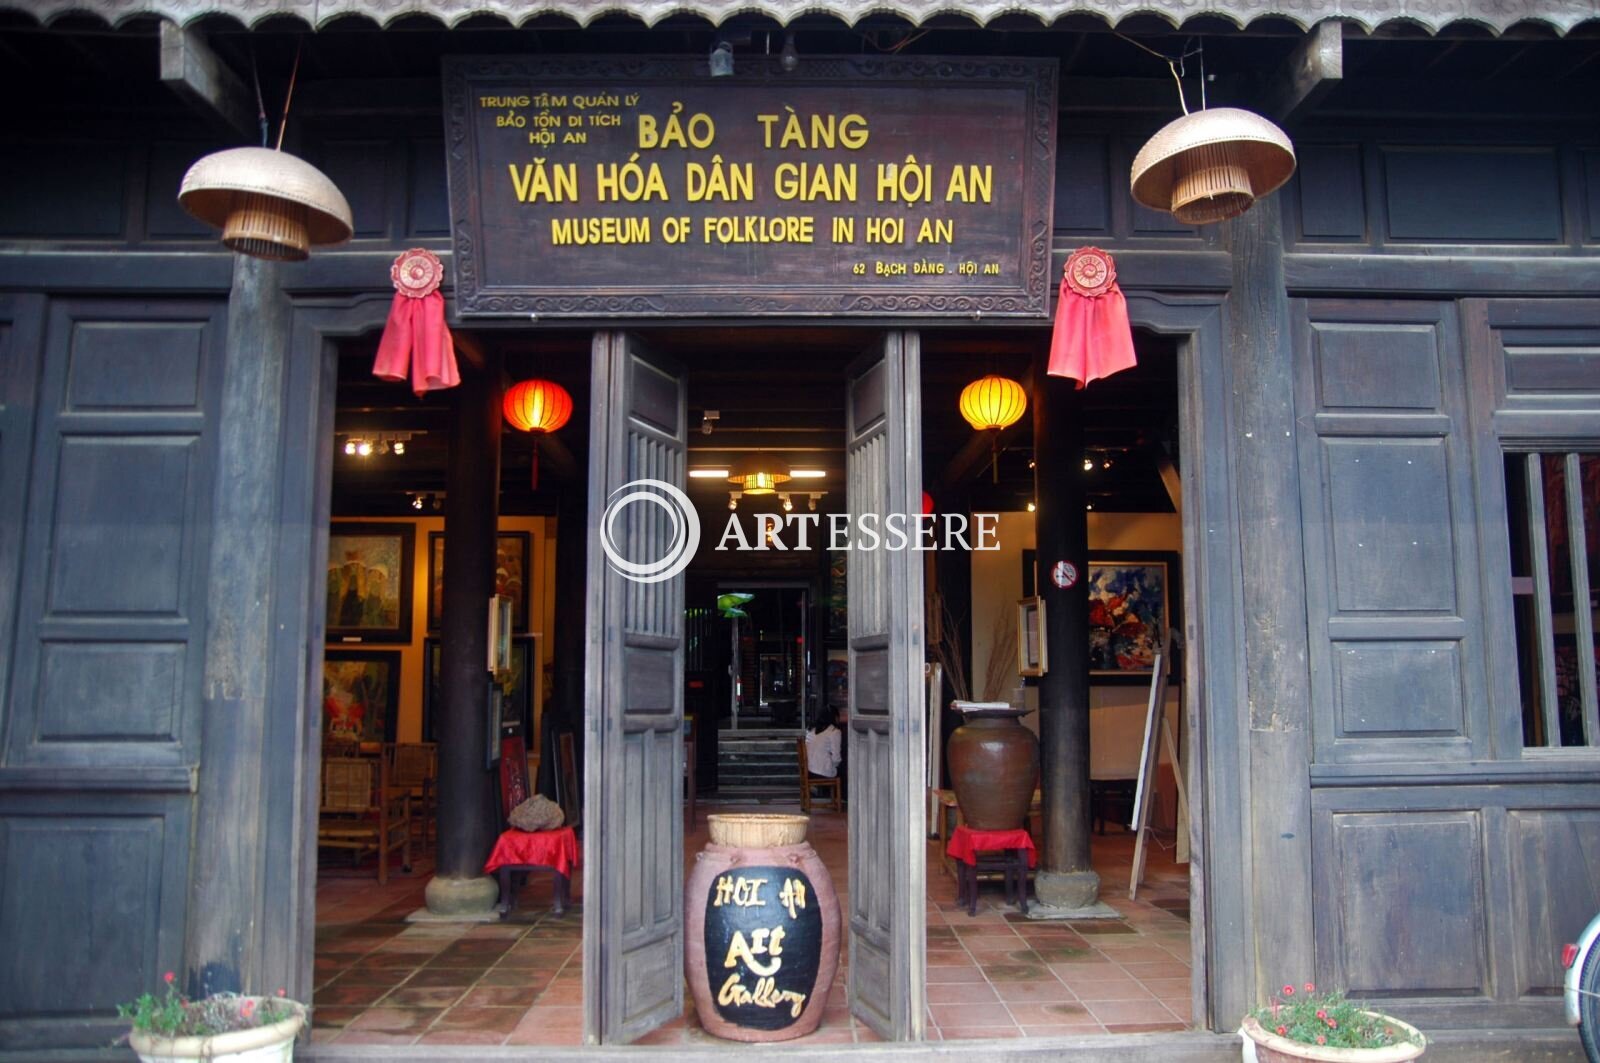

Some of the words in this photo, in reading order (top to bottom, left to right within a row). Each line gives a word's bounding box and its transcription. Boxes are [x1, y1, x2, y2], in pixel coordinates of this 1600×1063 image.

[480, 96, 530, 108] TRUNG
[534, 93, 568, 107] TÂM
[625, 92, 640, 107] LÝ
[496, 110, 526, 128] BẢO
[568, 116, 583, 128] DI
[589, 111, 622, 127] TÍCH
[638, 101, 715, 149] BẢO
[757, 105, 870, 150] TÀNG
[529, 129, 556, 148] HỘI
[563, 132, 588, 144] AN
[508, 156, 579, 203] VĂN
[596, 152, 670, 202] HÓA
[686, 154, 754, 202] DÂN
[774, 161, 858, 202] GIAN
[876, 153, 933, 207] HỘI
[945, 164, 993, 203] AN
[550, 216, 651, 245] MUSEUM
[661, 216, 692, 244] OF
[703, 215, 815, 244] FOLKLORE
[831, 216, 855, 244] IN
[865, 217, 905, 244] HOI
[916, 217, 954, 244] AN
[853, 263, 866, 275] 62
[958, 261, 978, 277] HỘI
[983, 263, 999, 275] AN
[718, 972, 806, 1018] Gallery
